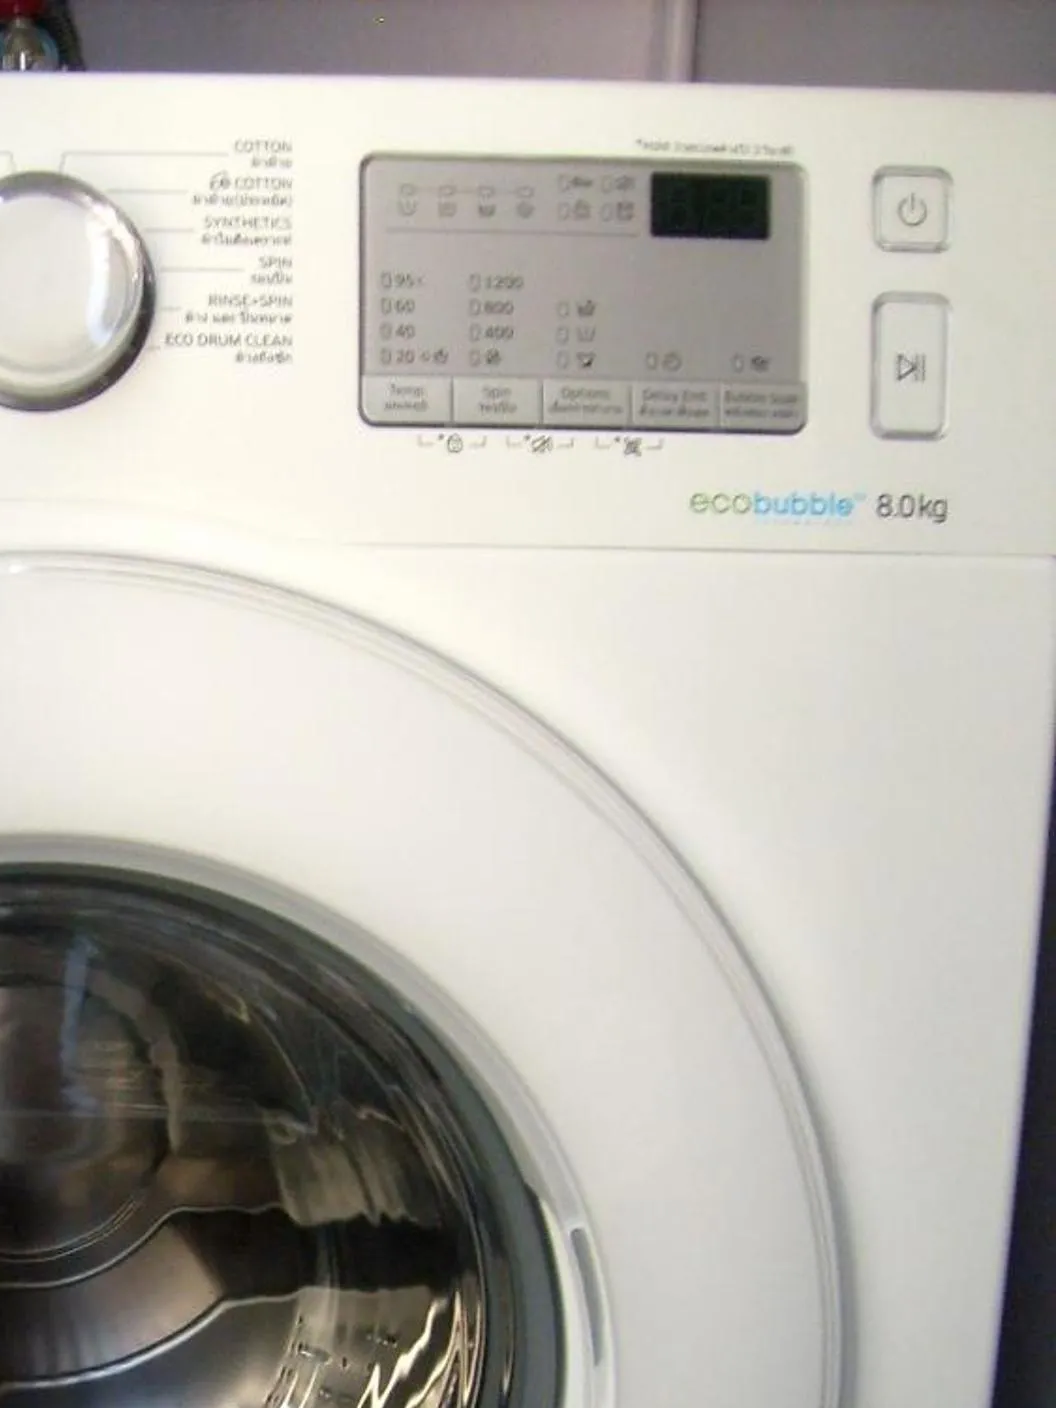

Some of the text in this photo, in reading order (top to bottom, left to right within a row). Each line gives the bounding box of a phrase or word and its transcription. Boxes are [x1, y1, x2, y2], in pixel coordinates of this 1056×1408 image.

[234, 140, 292, 153] COTTON
[234, 177, 292, 190] COTTON
[204, 216, 292, 230] SYNTHETICS
[258, 256, 292, 269] SPIN
[395, 323, 416, 340] 40
[484, 324, 515, 340] 400
[165, 332, 292, 347] ECO DRUM CLEAN
